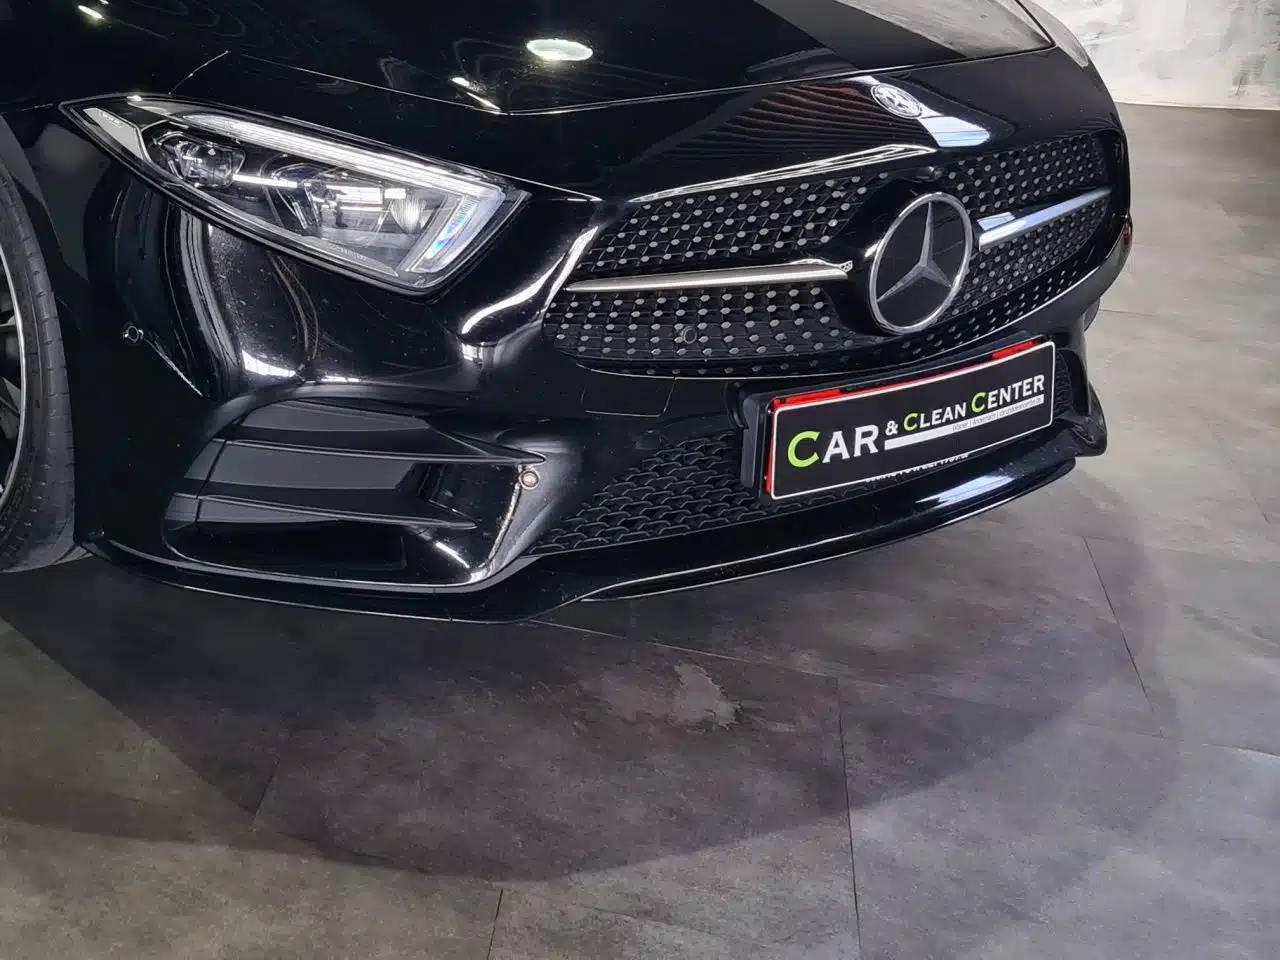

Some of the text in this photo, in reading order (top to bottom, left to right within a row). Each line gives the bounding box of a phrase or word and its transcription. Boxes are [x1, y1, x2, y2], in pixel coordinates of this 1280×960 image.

[787, 424, 879, 468] CAR
[885, 420, 898, 436] &
[903, 404, 967, 433] CLEAN
[971, 374, 1044, 413] CENTER
